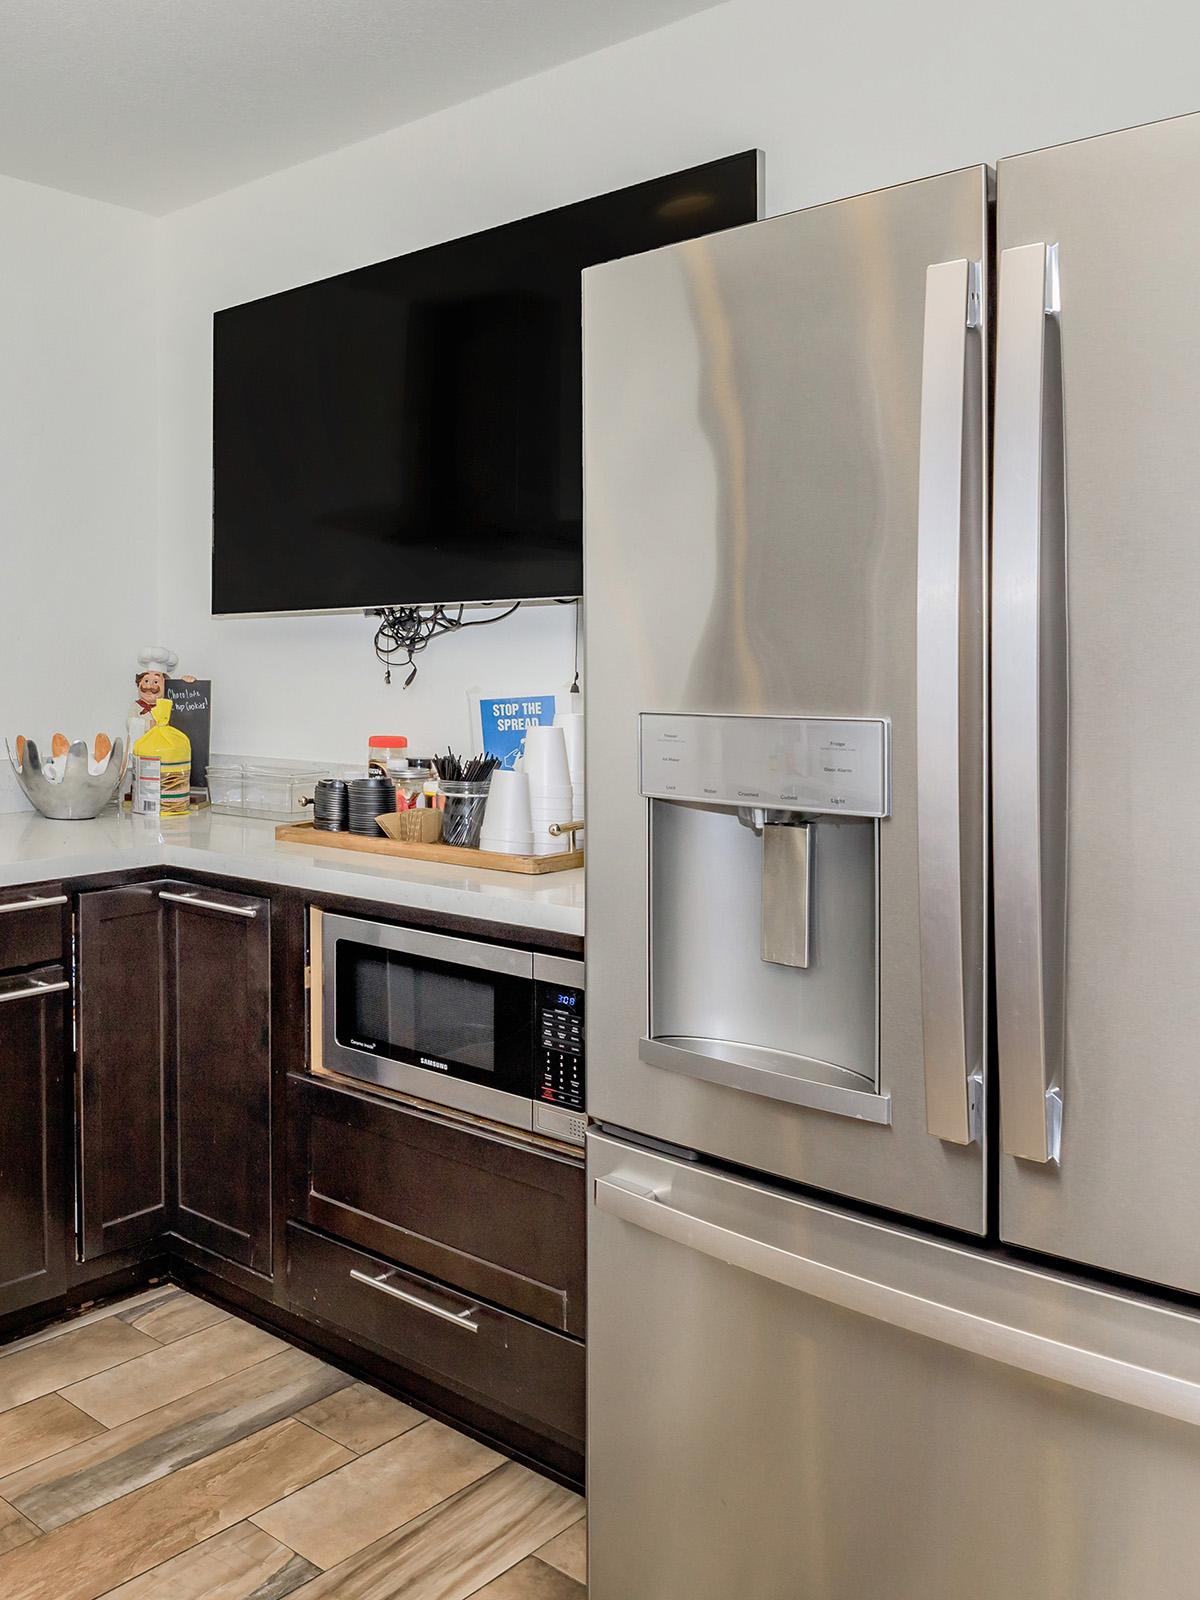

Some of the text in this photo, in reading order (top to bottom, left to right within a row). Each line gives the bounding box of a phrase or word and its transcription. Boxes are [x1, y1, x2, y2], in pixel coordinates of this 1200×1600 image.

[492, 702, 542, 716] STOP THE
[497, 717, 539, 731] SPREAD
[420, 1057, 448, 1071] SAMSUNG
